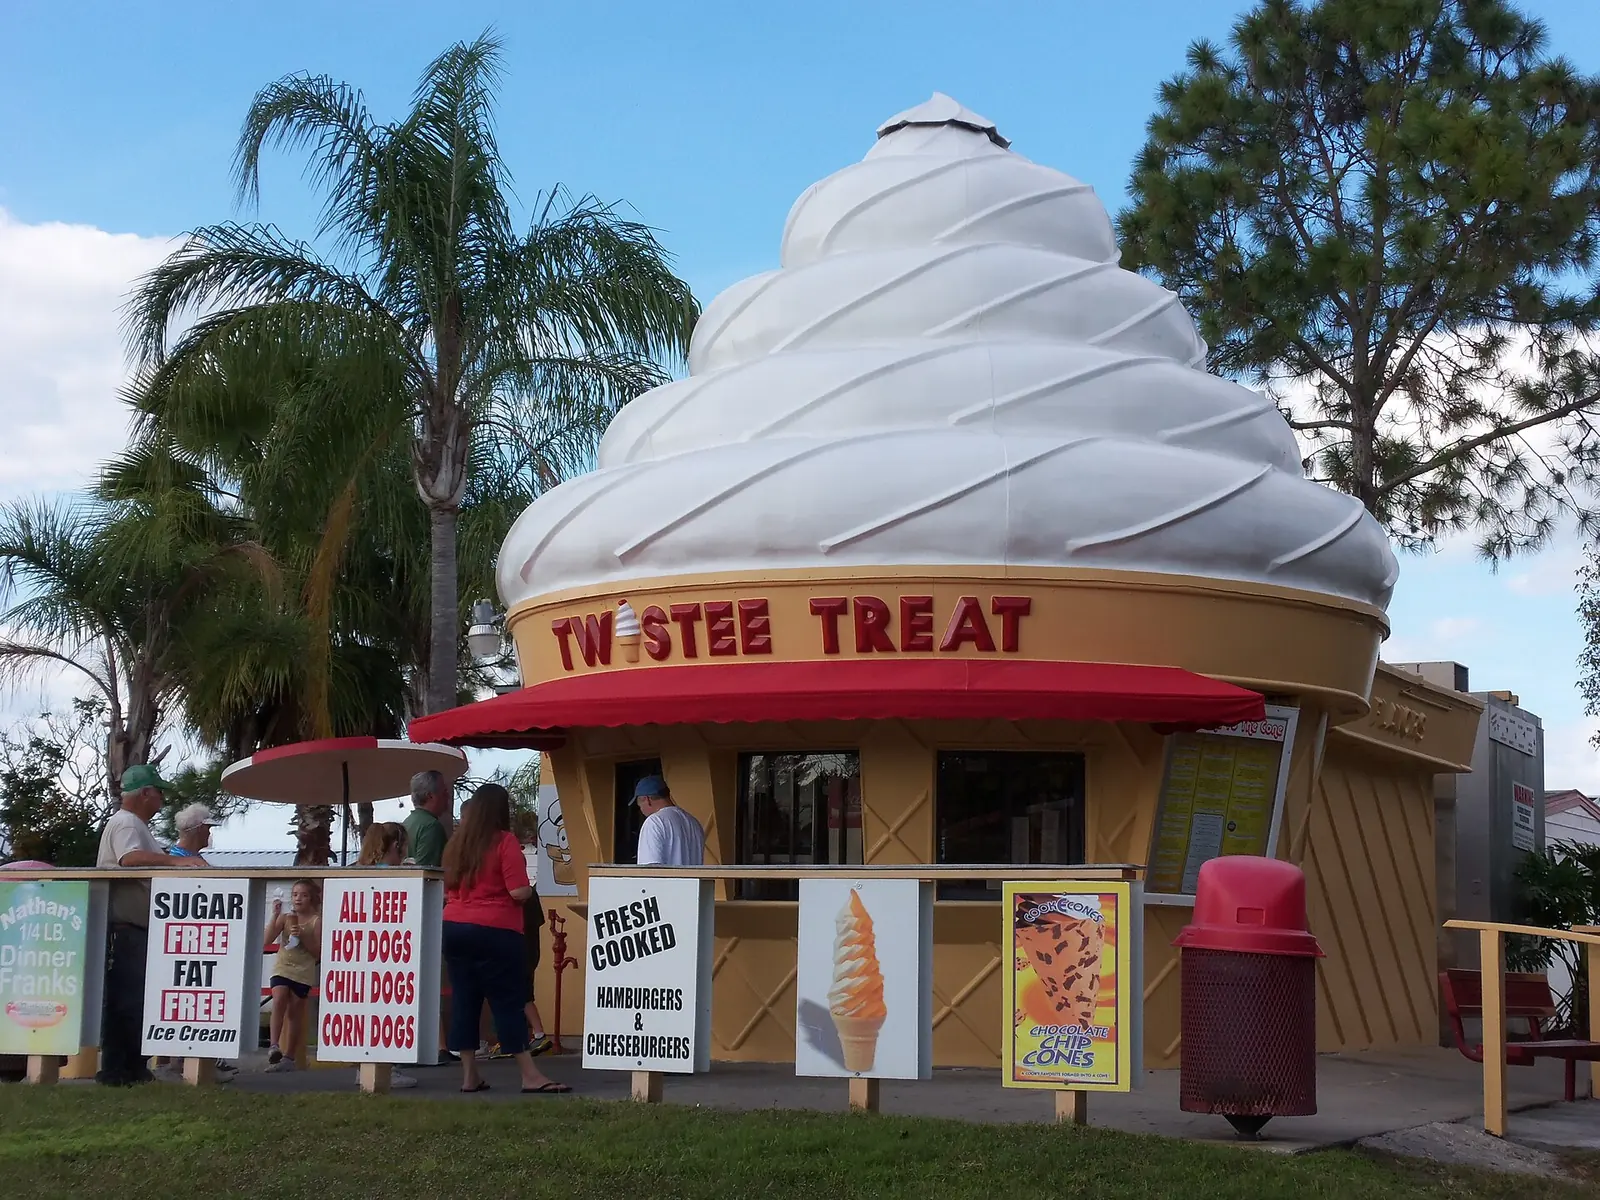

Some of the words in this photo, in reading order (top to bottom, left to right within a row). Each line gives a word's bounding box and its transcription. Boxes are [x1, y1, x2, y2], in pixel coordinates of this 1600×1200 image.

[809, 595, 1032, 655] TREAT
[0, 896, 83, 931] Nathan's
[153, 892, 244, 920] SUGAR
[339, 891, 367, 923] ALL
[372, 891, 408, 923] BEEF
[593, 896, 661, 940] FRESH
[19, 922, 41, 942] 1/4
[44, 922, 67, 942] LB.
[166, 924, 228, 954] FREE
[0, 944, 77, 968] Dinner
[331, 930, 363, 962] HOT
[367, 930, 412, 964] DOGS
[590, 922, 677, 972] COOKED
[0, 967, 78, 996] Franks
[173, 960, 217, 987] FAT
[325, 970, 366, 1004] CHILI
[370, 971, 415, 1005] DOGS
[162, 991, 225, 1021] FREE
[597, 986, 683, 1011] HAMBURGERS
[147, 1024, 175, 1041] Ice
[178, 1025, 237, 1043] Cream
[322, 1013, 365, 1047] CORN
[370, 1014, 415, 1049] DOGS
[634, 1012, 644, 1031] &
[1029, 1024, 1109, 1038] CHOCOLATE
[587, 1033, 690, 1060] CHEESEBURGERS
[1040, 1036, 1092, 1050] CHIP
[1022, 1049, 1095, 1068] CONES
